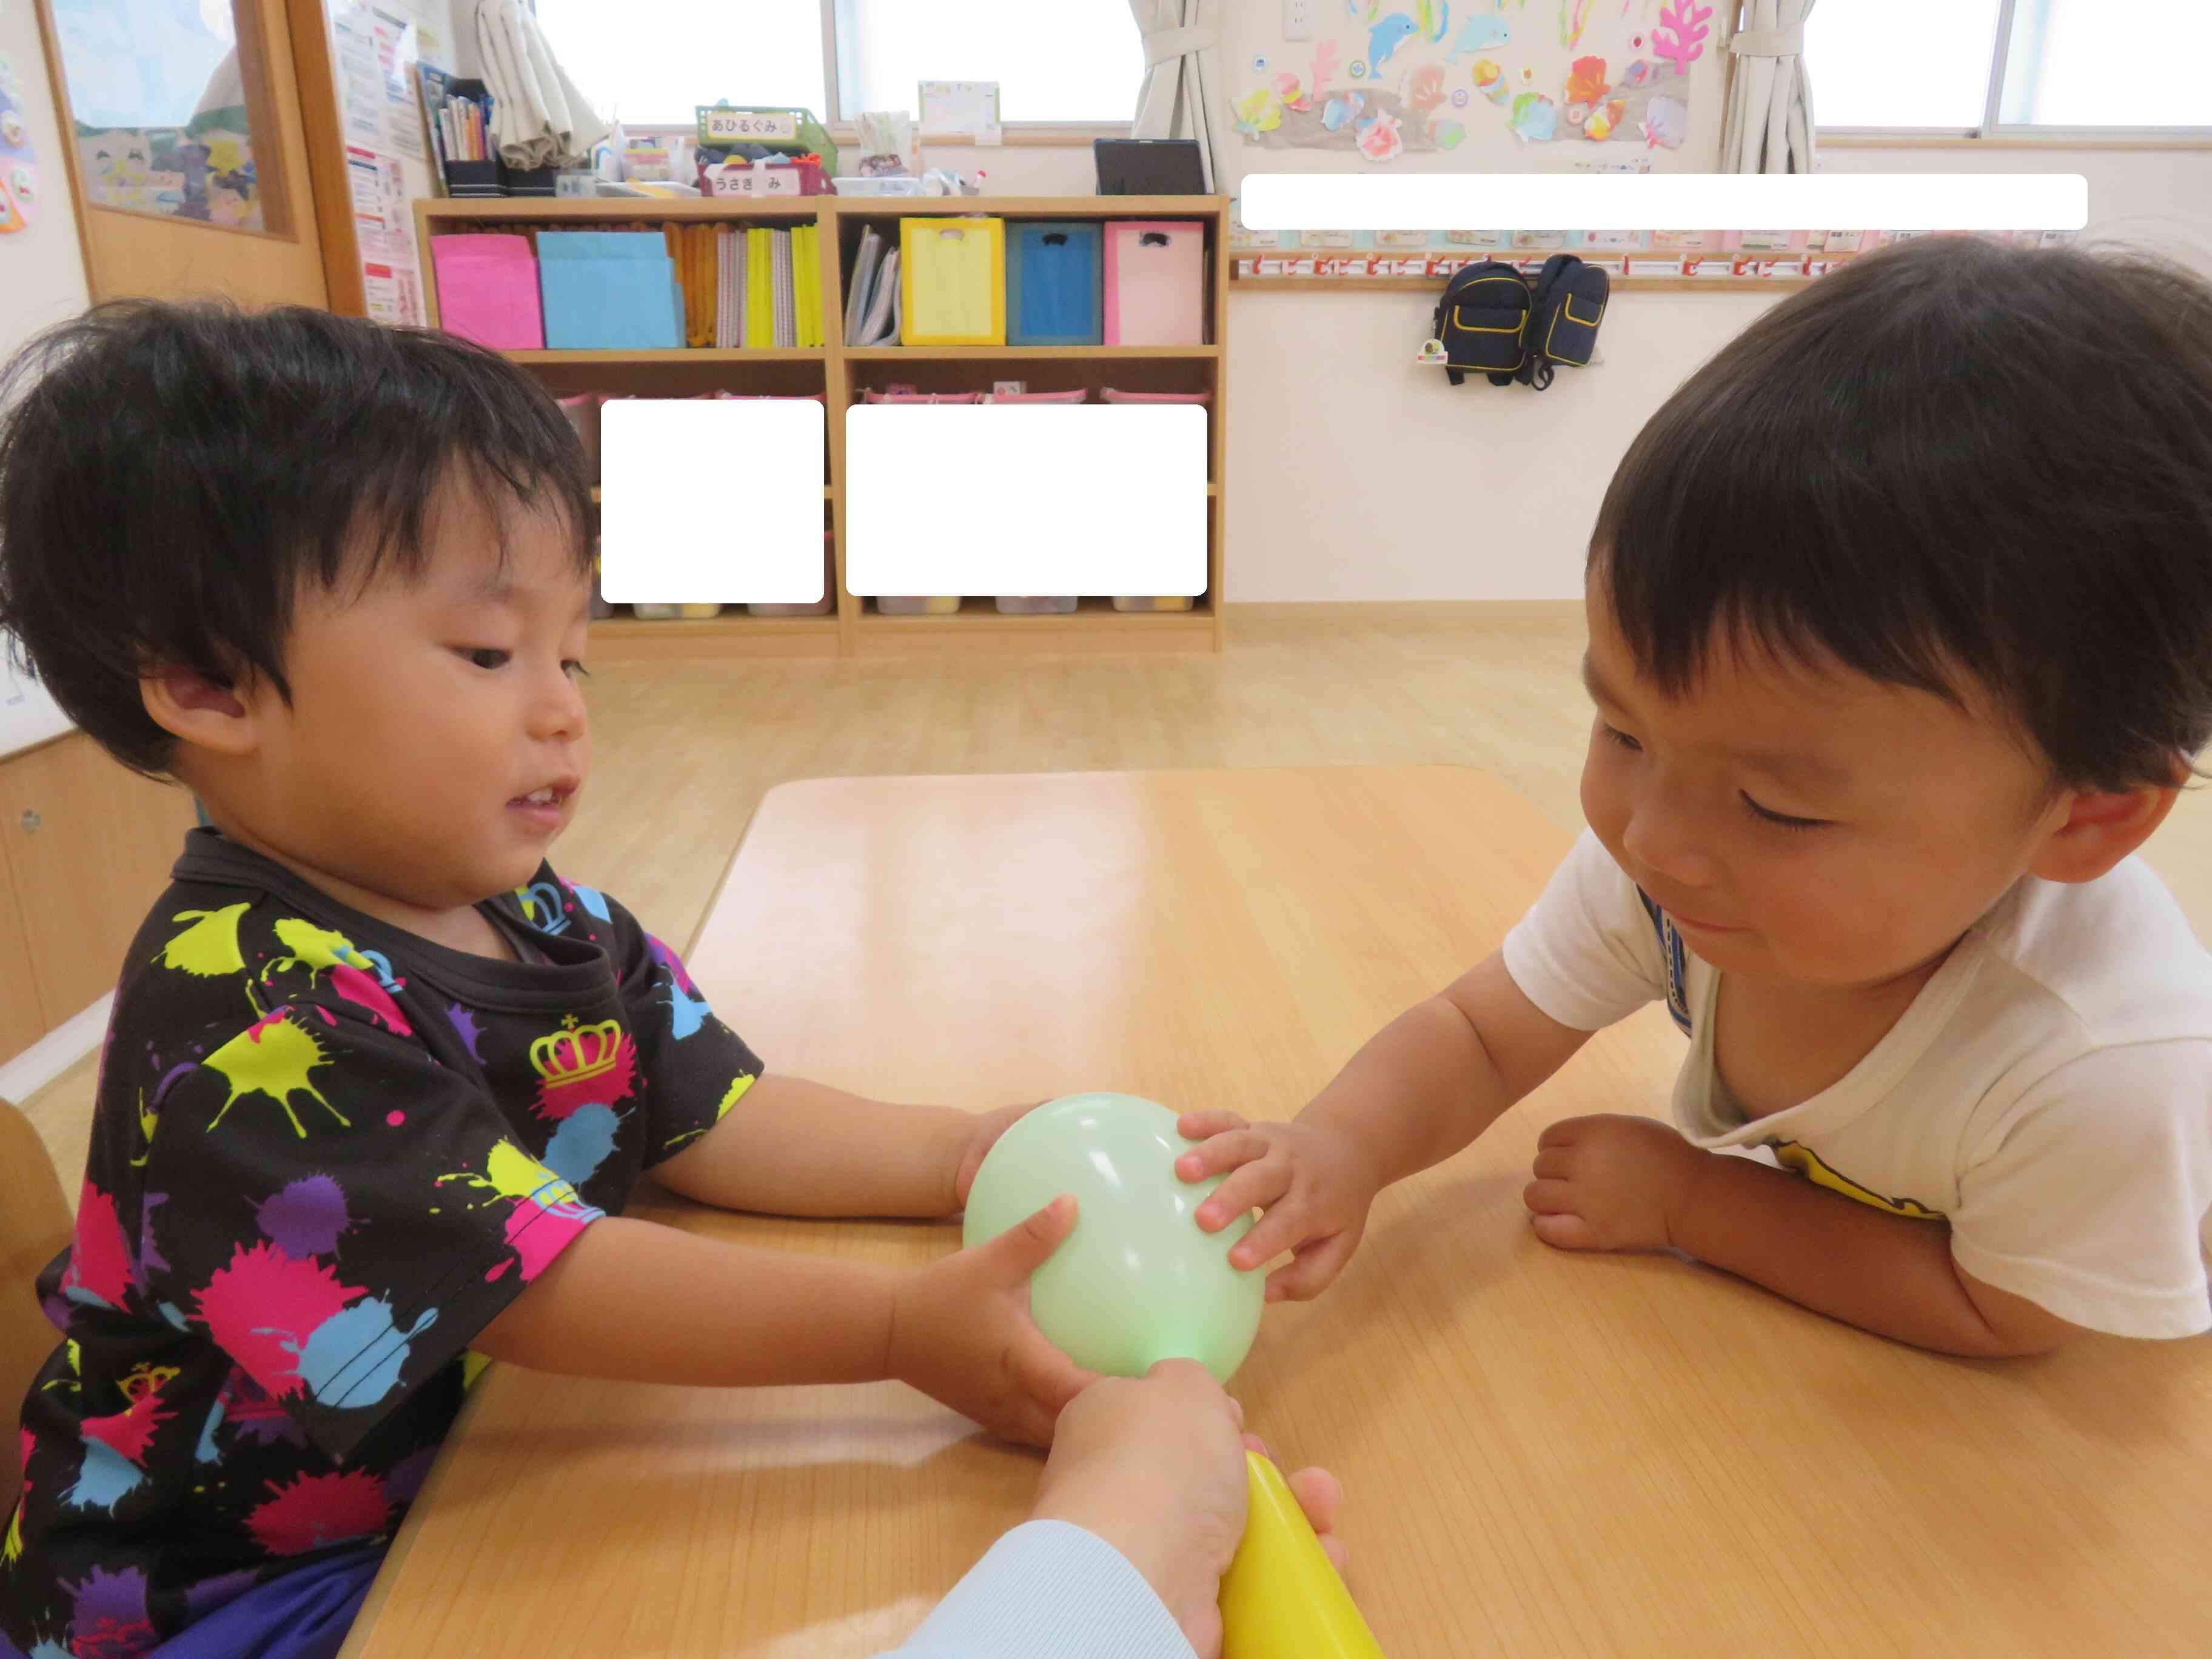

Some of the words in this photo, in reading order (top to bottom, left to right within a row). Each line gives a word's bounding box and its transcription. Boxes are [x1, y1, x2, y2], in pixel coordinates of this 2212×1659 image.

[712, 119, 777, 132] あひるぐみ
[716, 176, 781, 190] うさぎみ
